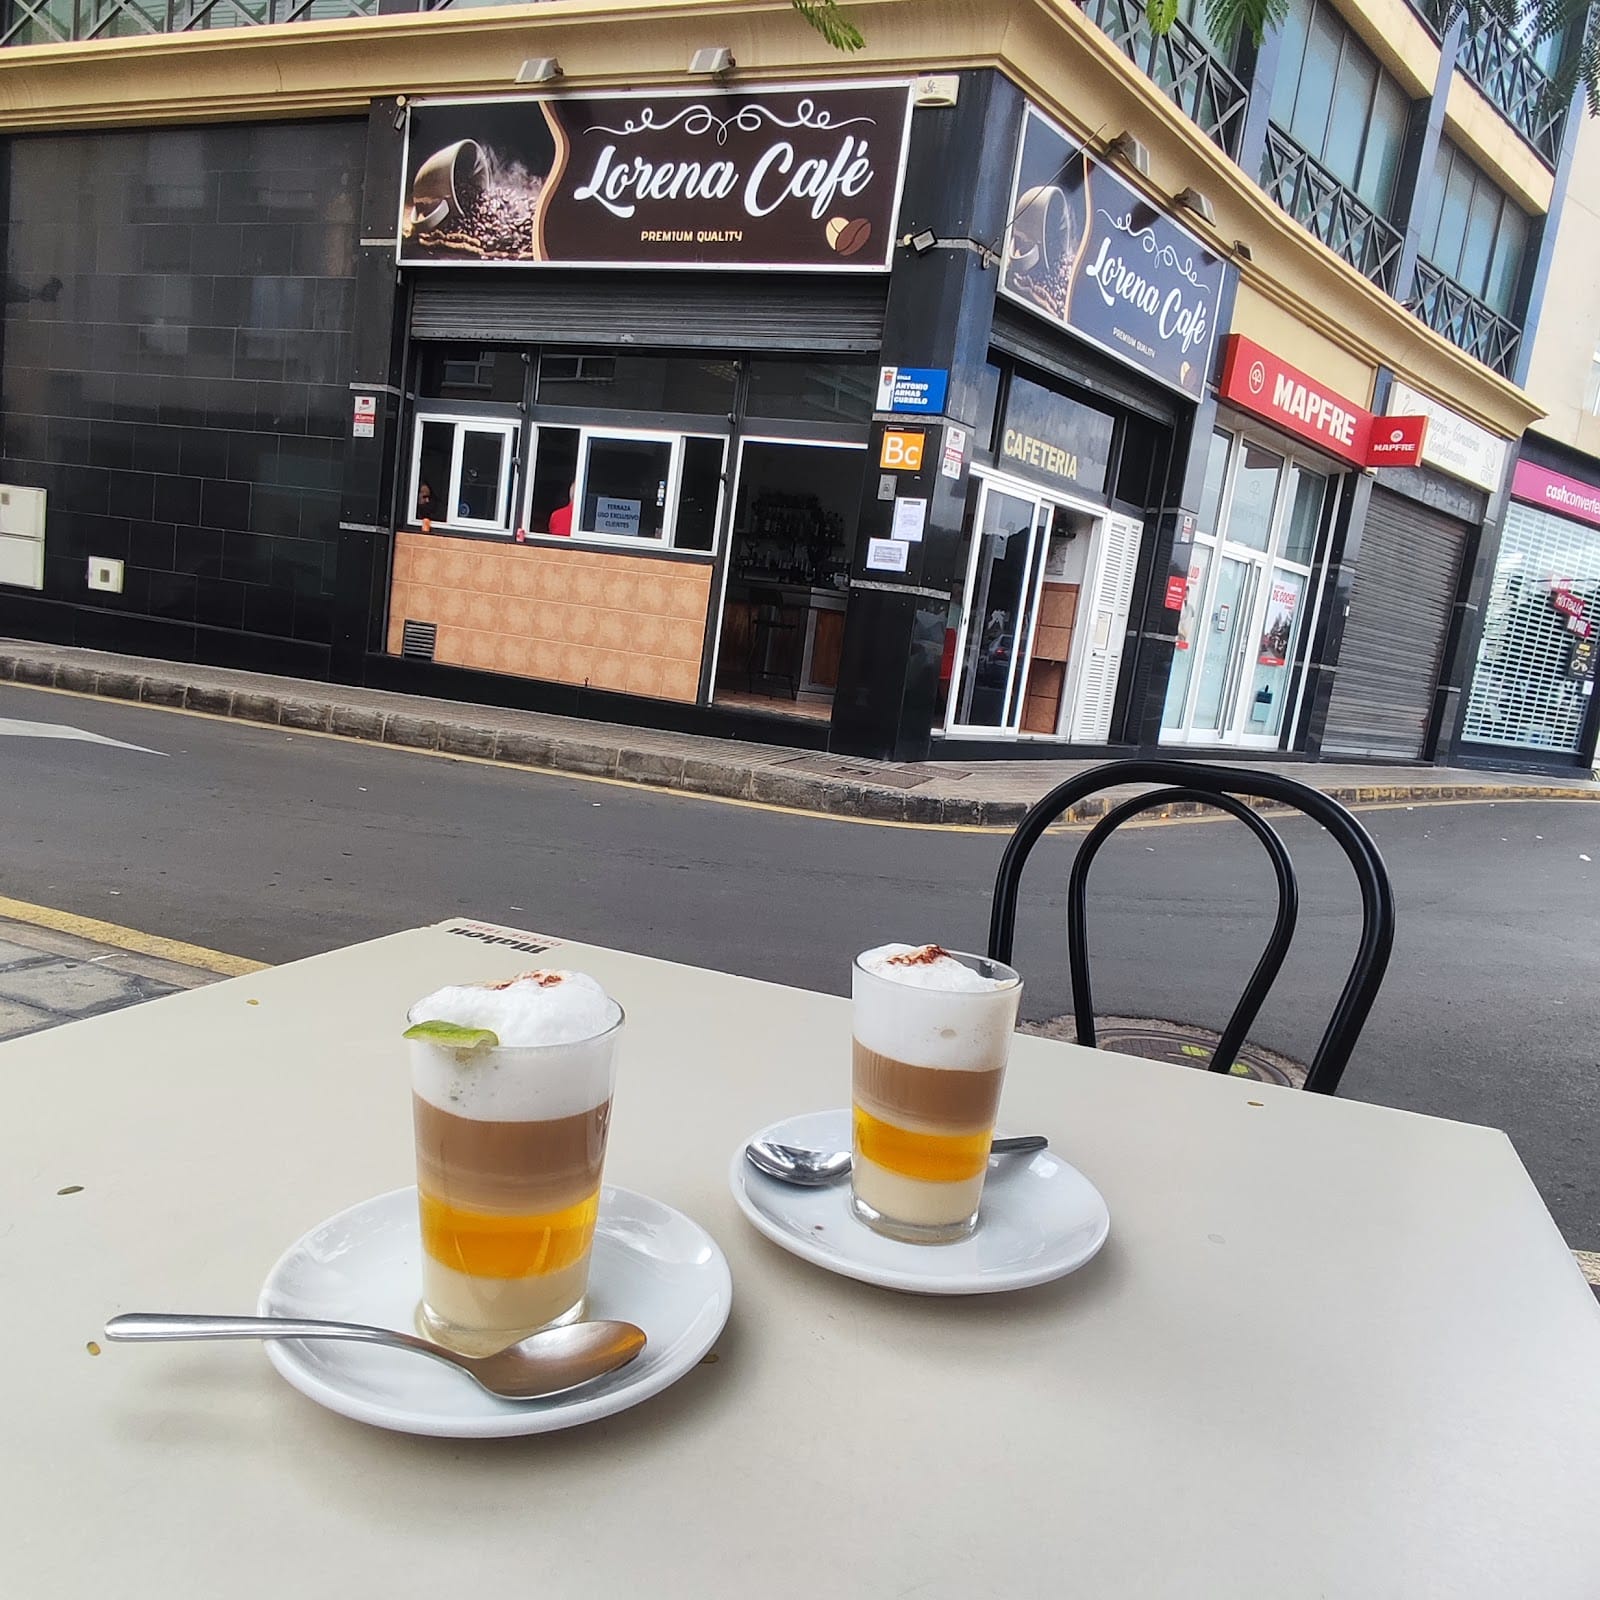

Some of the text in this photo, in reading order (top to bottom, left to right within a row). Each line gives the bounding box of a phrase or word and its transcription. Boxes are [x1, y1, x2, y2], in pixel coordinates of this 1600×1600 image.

[573, 135, 874, 220] Lorena Café
[640, 231, 743, 243] PREMIUM QUALITY
[1086, 237, 1207, 353] Lorena Café
[1112, 327, 1156, 358] PREMIUM QUALITY
[894, 389, 921, 398] ARMAS
[895, 382, 929, 391] ANTONIO
[893, 396, 928, 405] CURBELO
[1272, 373, 1357, 447] MAPFRE
[884, 436, 920, 465] Bc
[1003, 429, 1077, 480] CAFETERIA
[1373, 443, 1416, 452] MAPFRE
[607, 503, 631, 511] TERRAZA
[610, 512, 639, 520] EXCLUSIVO
[446, 927, 550, 954] Mahou
